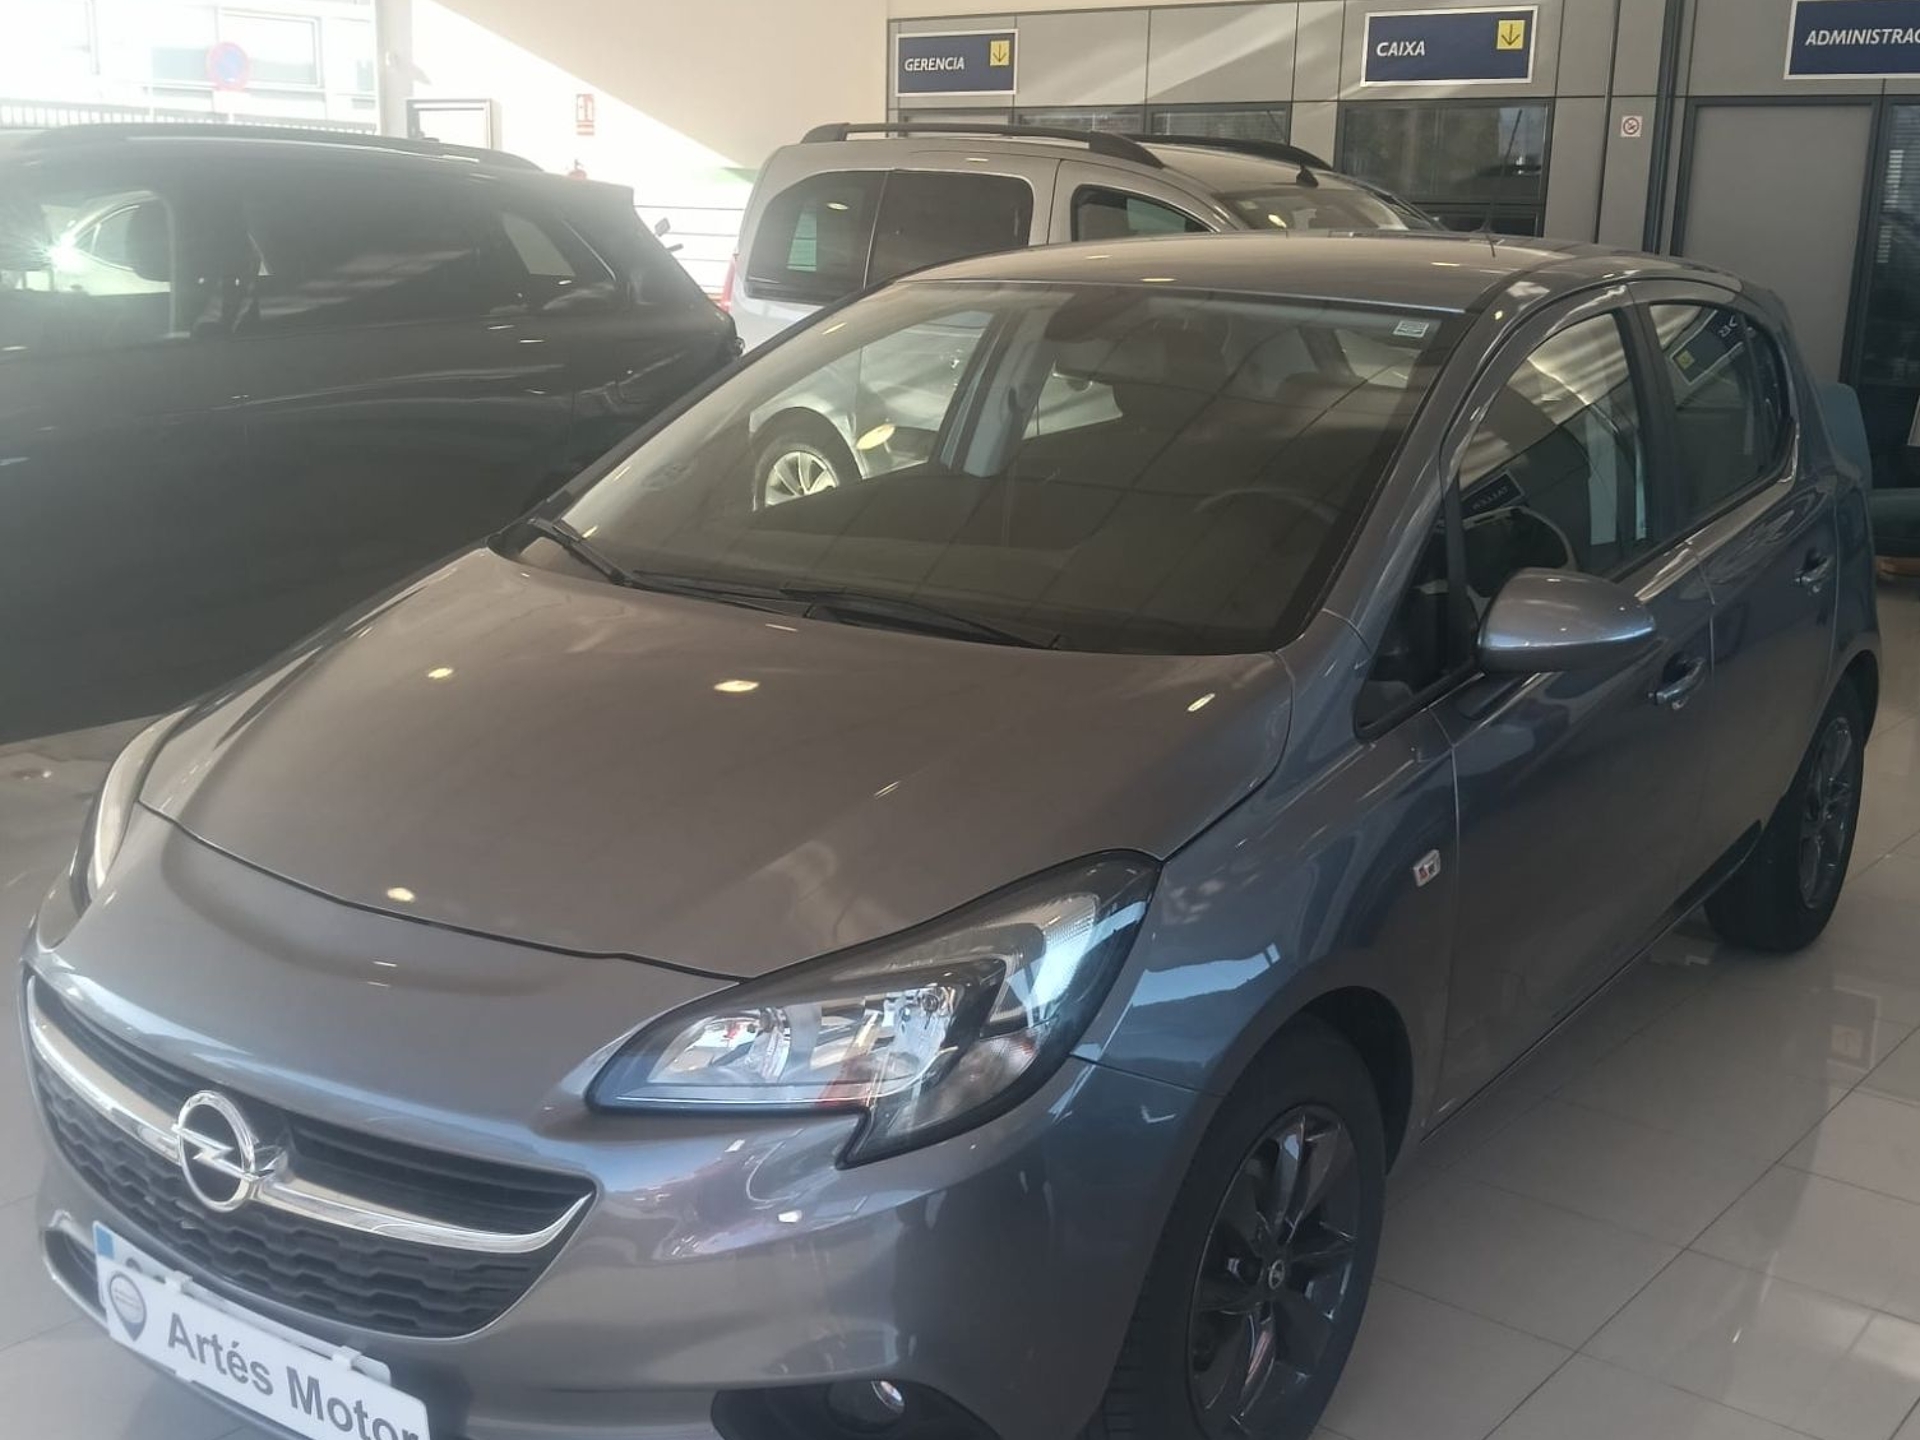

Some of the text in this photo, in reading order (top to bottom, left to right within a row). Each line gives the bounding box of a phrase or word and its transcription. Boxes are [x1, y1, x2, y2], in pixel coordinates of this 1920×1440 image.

[1376, 41, 1426, 57] CAIXA
[904, 57, 965, 71] GERENCIA
[168, 1312, 273, 1396] Artés
